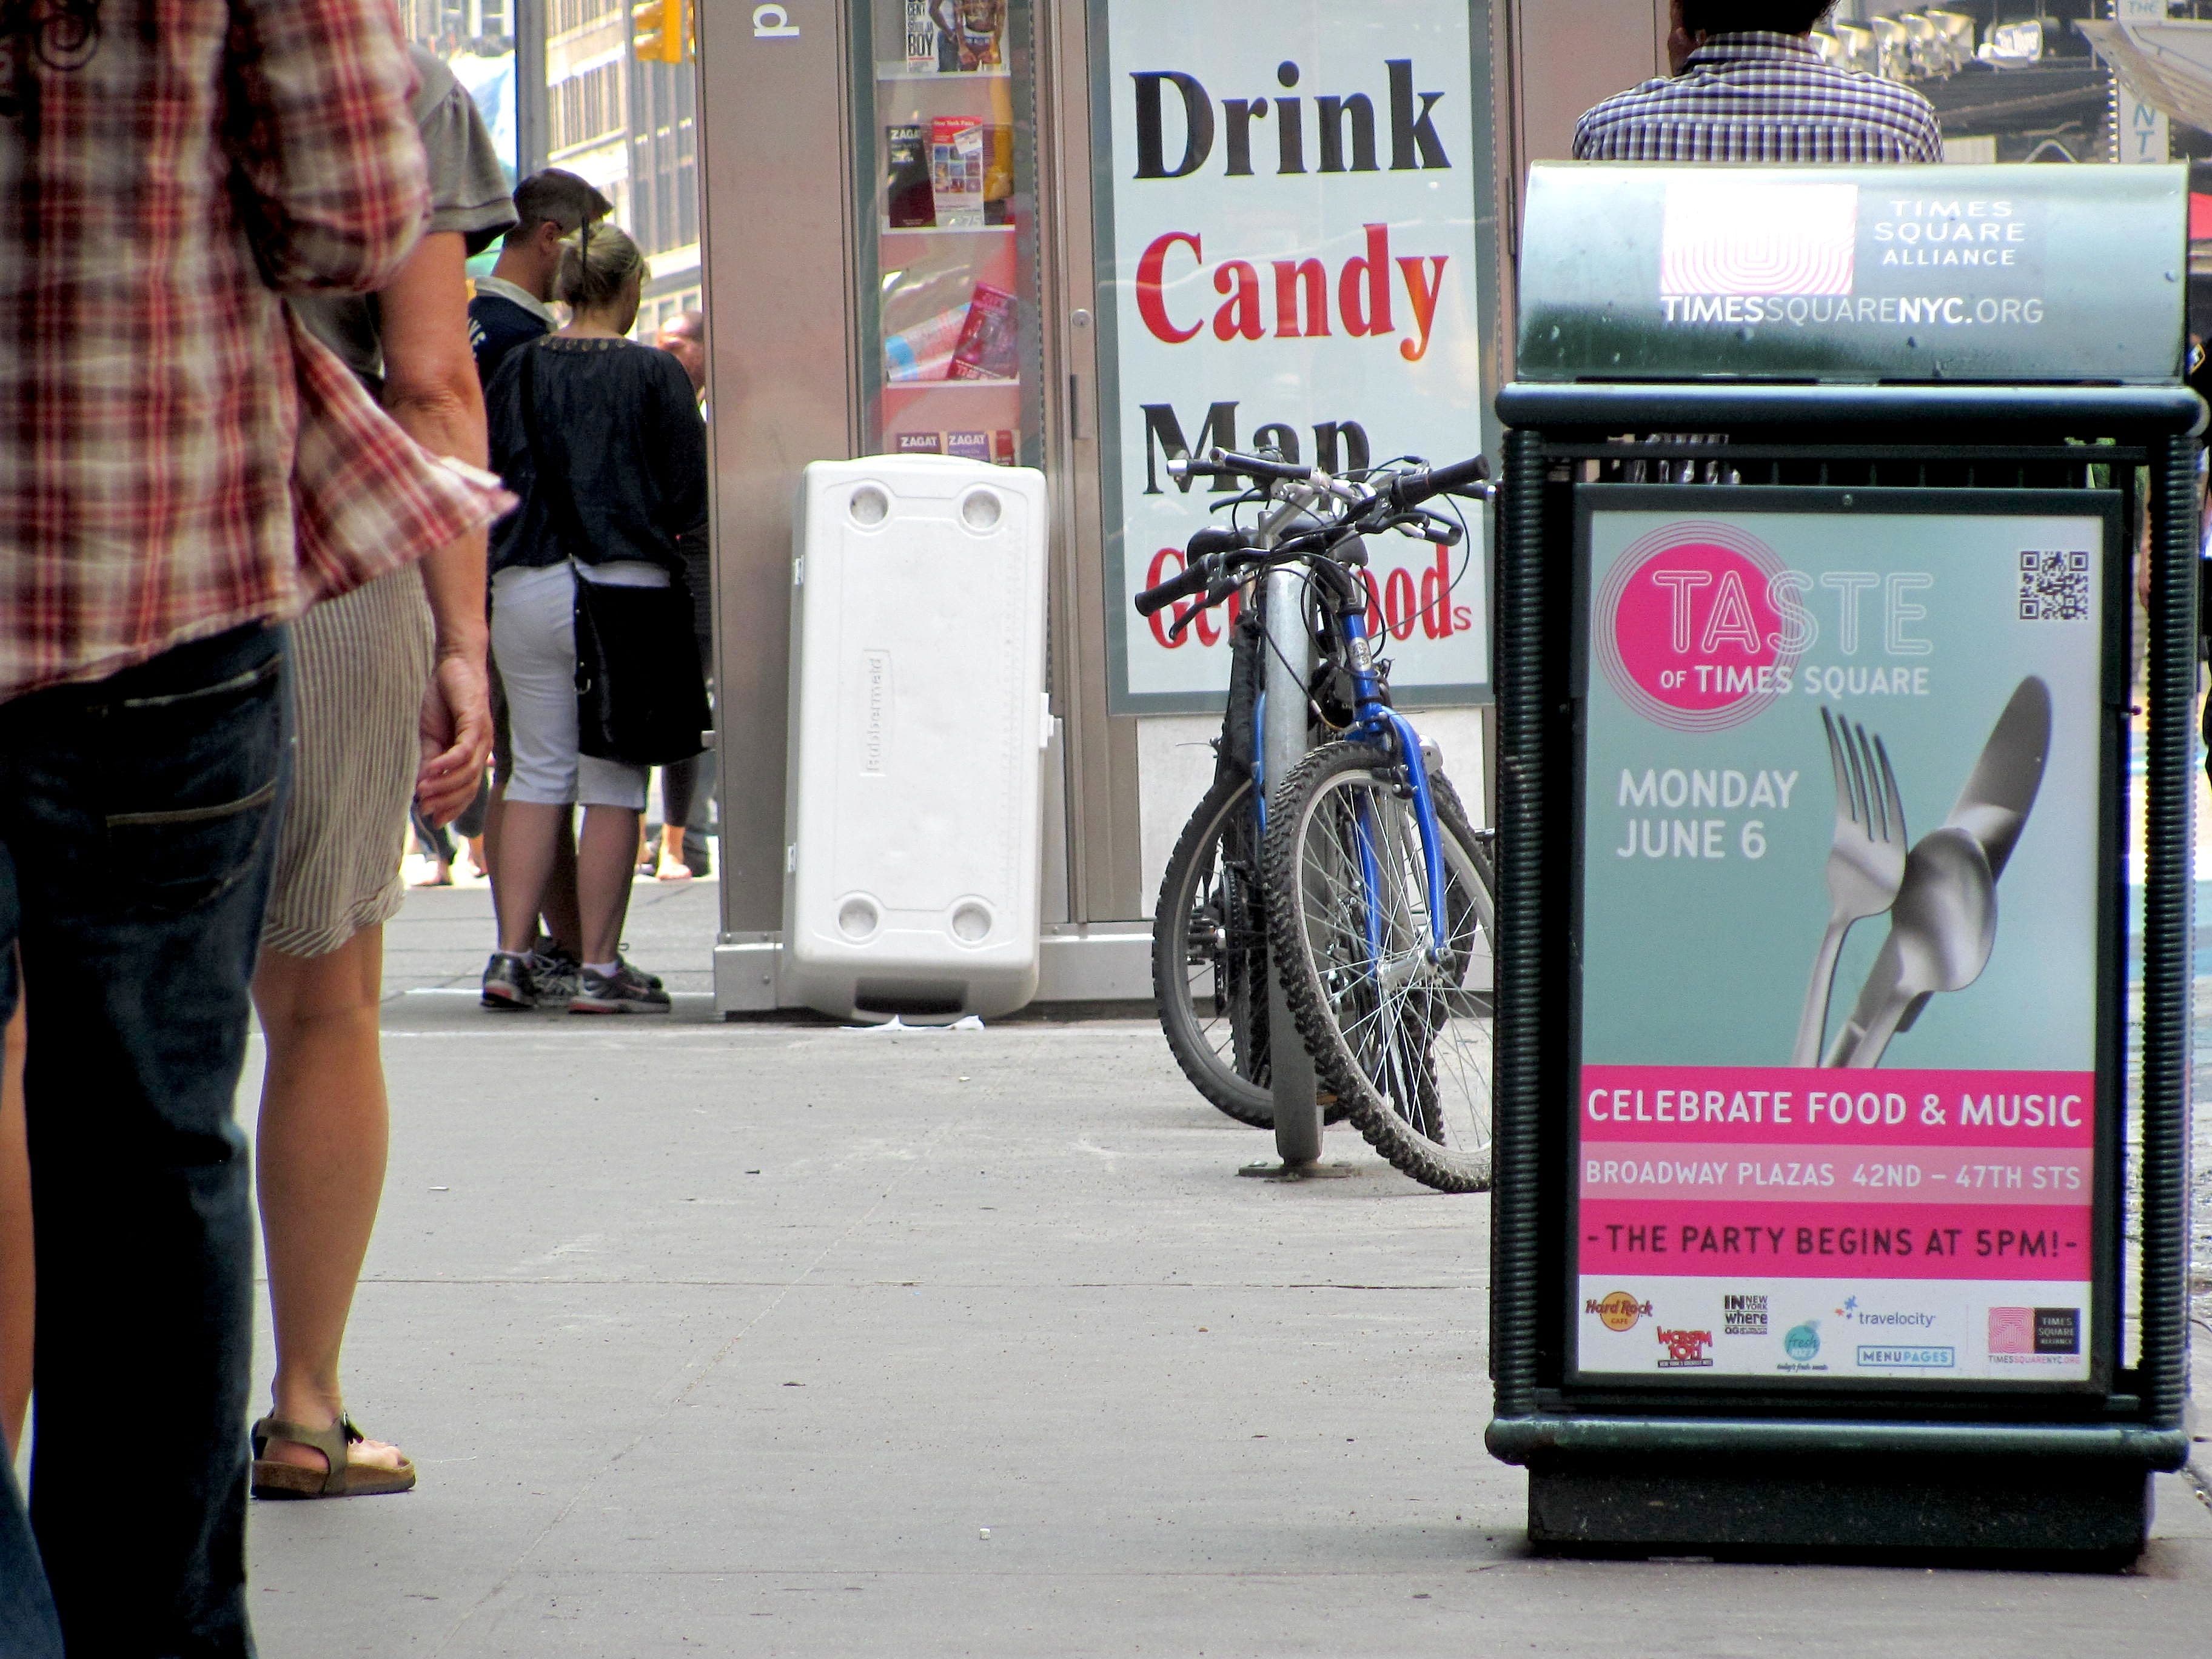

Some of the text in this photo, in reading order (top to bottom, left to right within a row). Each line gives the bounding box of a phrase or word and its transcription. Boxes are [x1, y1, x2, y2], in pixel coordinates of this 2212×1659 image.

[908, 32, 934, 56] BOY
[1129, 59, 1453, 179] Drink
[1890, 200, 2014, 218] TIMES
[1874, 222, 2026, 241] SQUARE
[1883, 249, 2016, 265] ALLIANCE
[1136, 223, 1449, 362] Candy
[1661, 295, 2044, 324] TIMESSQUARENYC.ORG
[901, 437, 938, 446] ZAGAT
[949, 434, 985, 445] ZAGAT
[1652, 569, 1934, 655] TASTE
[1660, 665, 1931, 699] OF TIMES SQUARE
[1618, 768, 1800, 808] MONDAY
[1615, 819, 1768, 859] JUNE 6
[1588, 1088, 2082, 1127] CELEBRATE FOOD & MUSIC
[1586, 1160, 1729, 1185] BROADWAY
[1737, 1162, 1835, 1187] PLAZAS
[1852, 1163, 1922, 1187] 42ND
[1956, 1164, 2022, 1189] 47TH
[2032, 1165, 2082, 1190] STS
[1681, 1225, 1785, 1254] PARTY
[1797, 1227, 1913, 1256] BEGINS
[1925, 1228, 1963, 1256] AT
[1585, 1299, 1653, 1318] Hard Rock
[1724, 1295, 1744, 1310] IN
[1726, 1312, 1768, 1325] where
[1859, 1312, 1933, 1328] travelocity
[2042, 1317, 2072, 1326] TIMES
[2038, 1327, 2074, 1336] SQUARE
[1863, 1350, 1948, 1362] MENUPAGES
[1989, 1355, 2080, 1364] TIMESSQUARENYC.ORG
